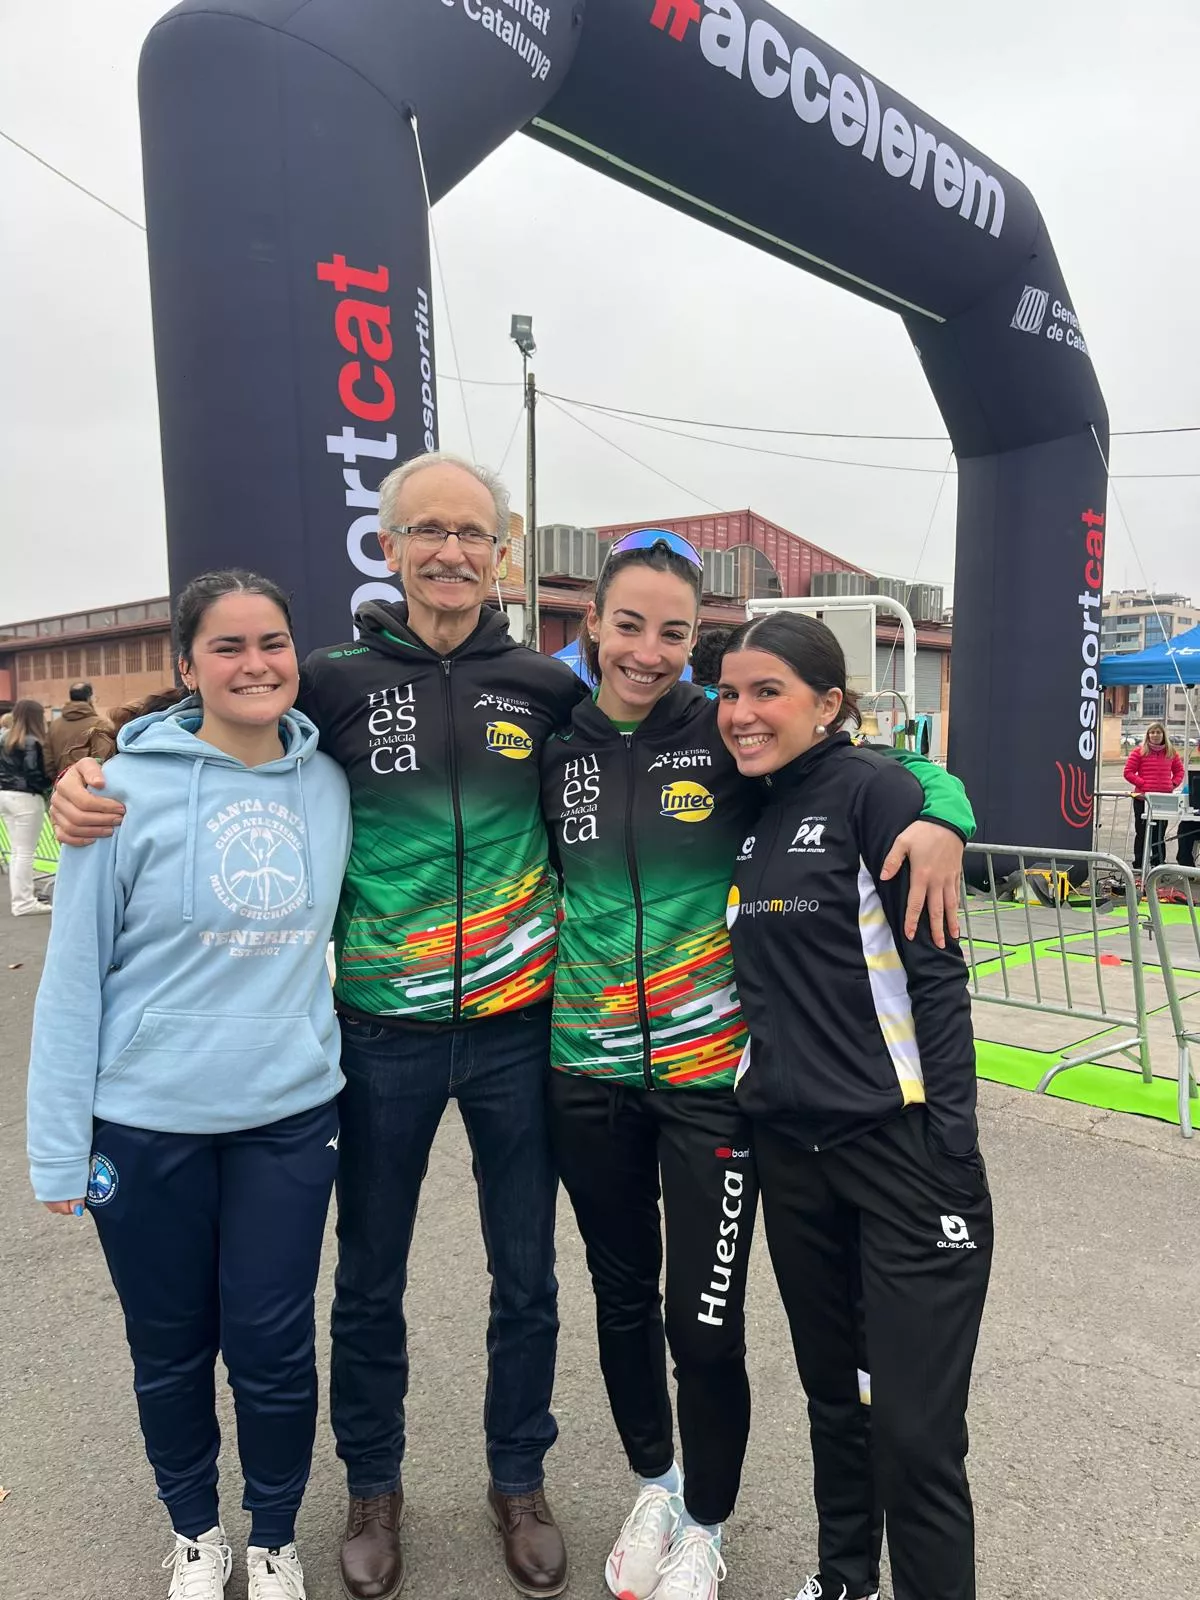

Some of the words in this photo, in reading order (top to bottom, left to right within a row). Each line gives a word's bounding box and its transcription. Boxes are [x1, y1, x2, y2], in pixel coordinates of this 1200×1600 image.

[463, 0, 551, 80] Catalunya
[1046, 323, 1063, 341] de
[414, 287, 434, 452] esportiu
[1078, 508, 1104, 760] esportcat
[368, 705, 416, 735] es
[672, 755, 712, 769] ZOITI
[673, 748, 710, 757] ATLETISMO
[563, 775, 600, 808] es
[206, 798, 265, 833] SANTA
[215, 823, 241, 850] CLUB
[698, 1170, 743, 1326] Huesca
